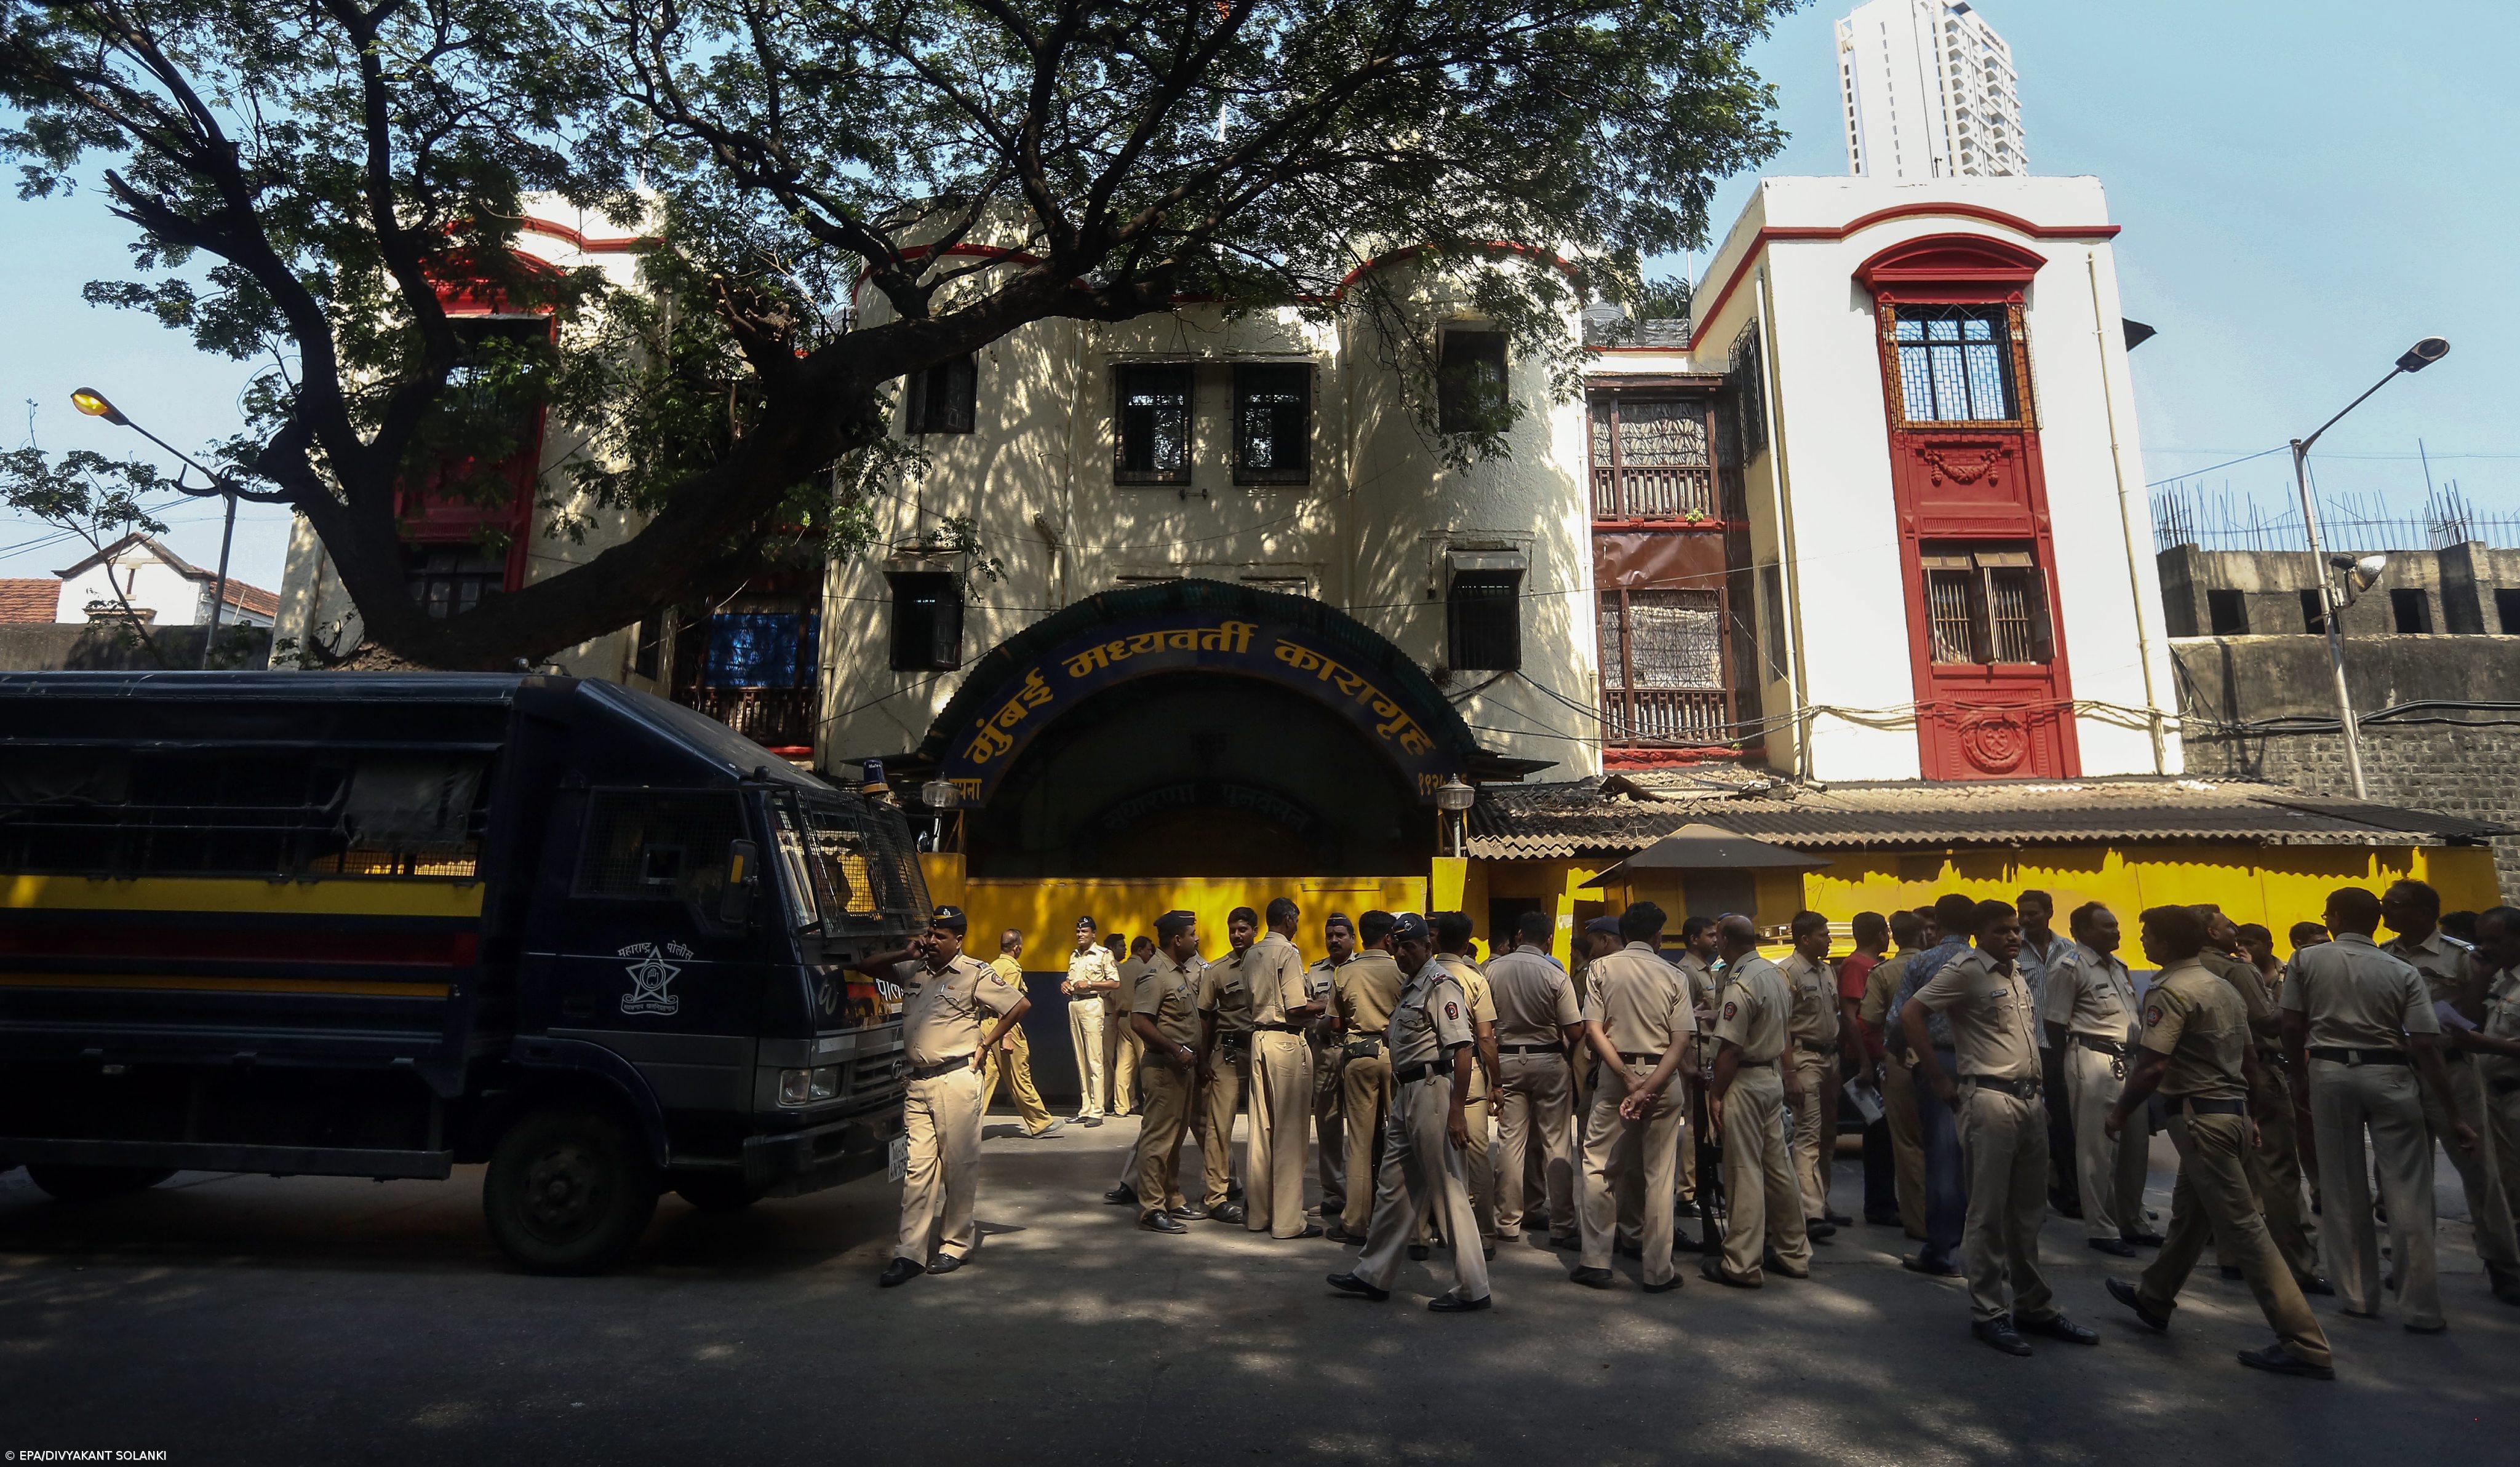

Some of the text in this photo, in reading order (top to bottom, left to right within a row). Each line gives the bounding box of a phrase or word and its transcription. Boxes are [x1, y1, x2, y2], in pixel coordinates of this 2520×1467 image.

[963, 621, 1436, 764] मुंबई मध्यवर्ती कारागृह
[617, 940, 695, 961] महाराष्ट्र पोलीस
